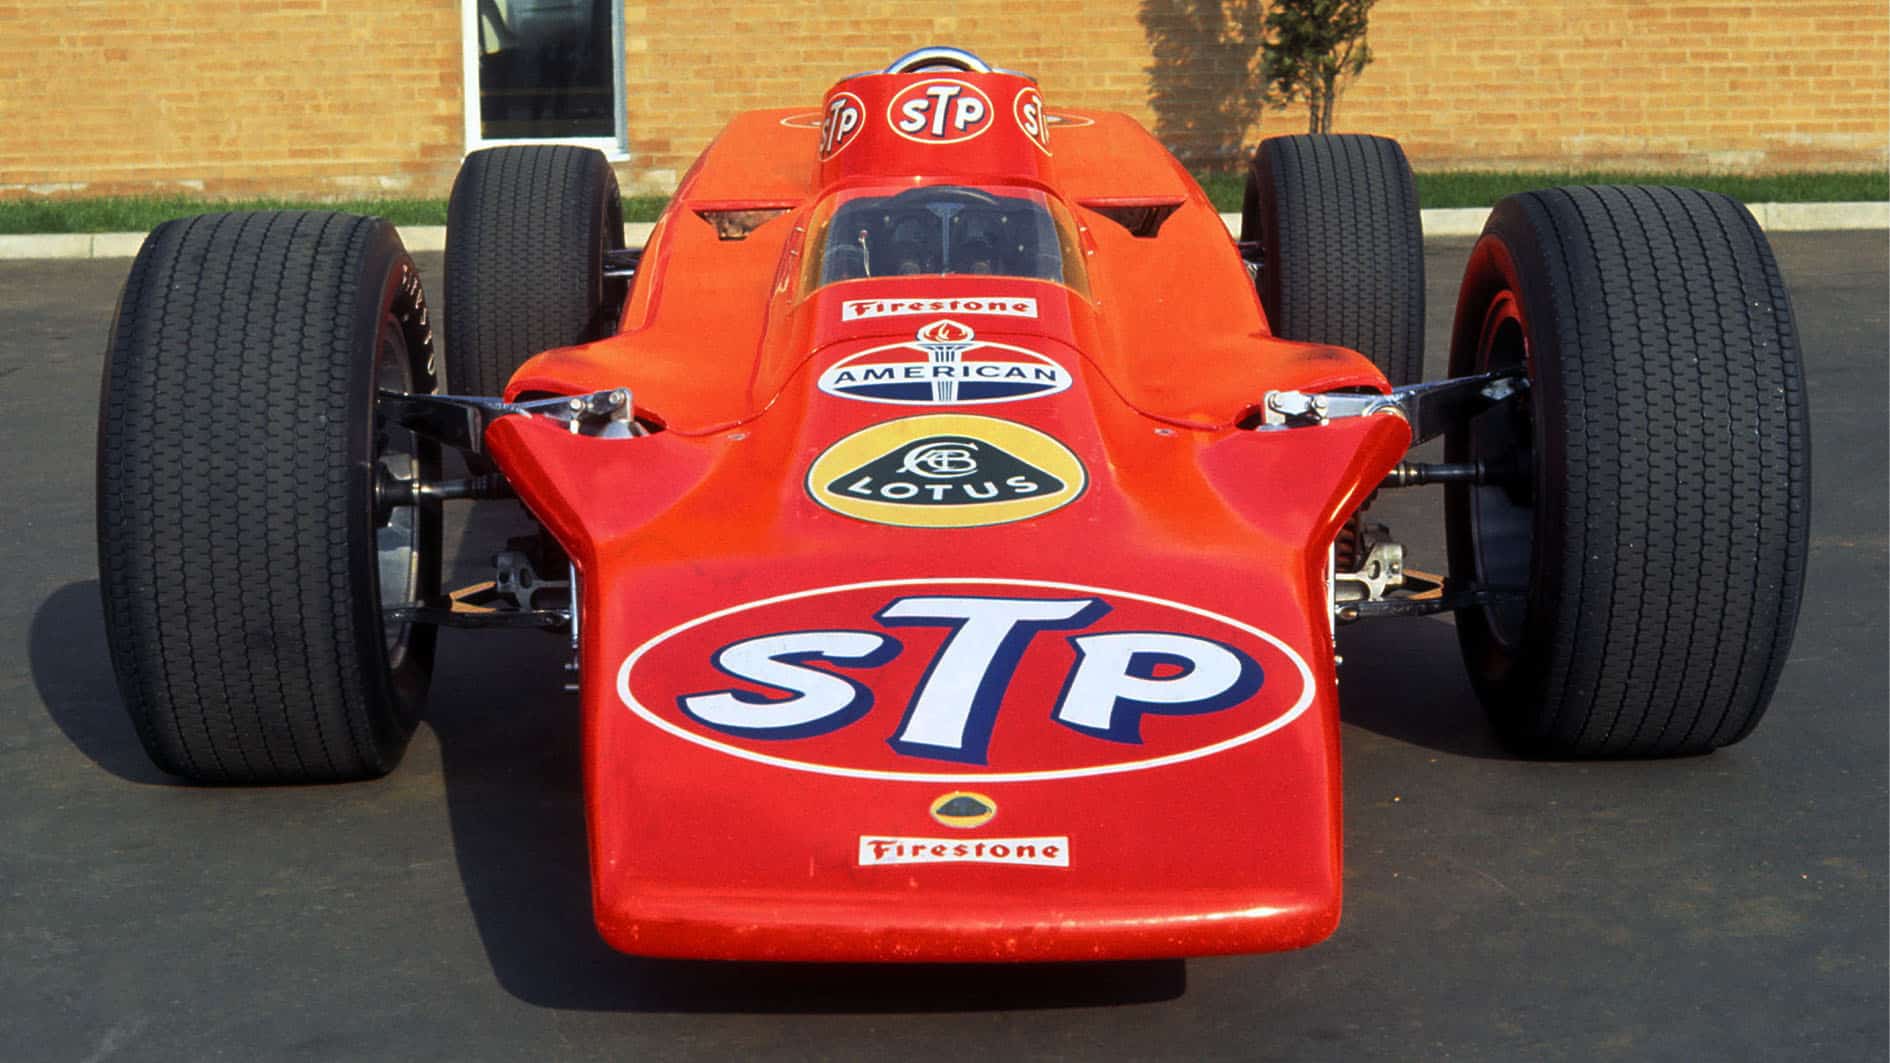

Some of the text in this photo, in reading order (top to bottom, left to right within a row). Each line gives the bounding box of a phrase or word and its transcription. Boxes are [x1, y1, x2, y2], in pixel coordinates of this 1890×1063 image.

[899, 85, 986, 137] STP
[1024, 95, 1050, 145] ST
[848, 301, 1031, 317] Firestone
[835, 365, 1057, 385] AMERICAN
[848, 475, 1039, 500] LOTUS
[676, 596, 1265, 766] STP
[867, 840, 1060, 860] Firestone
